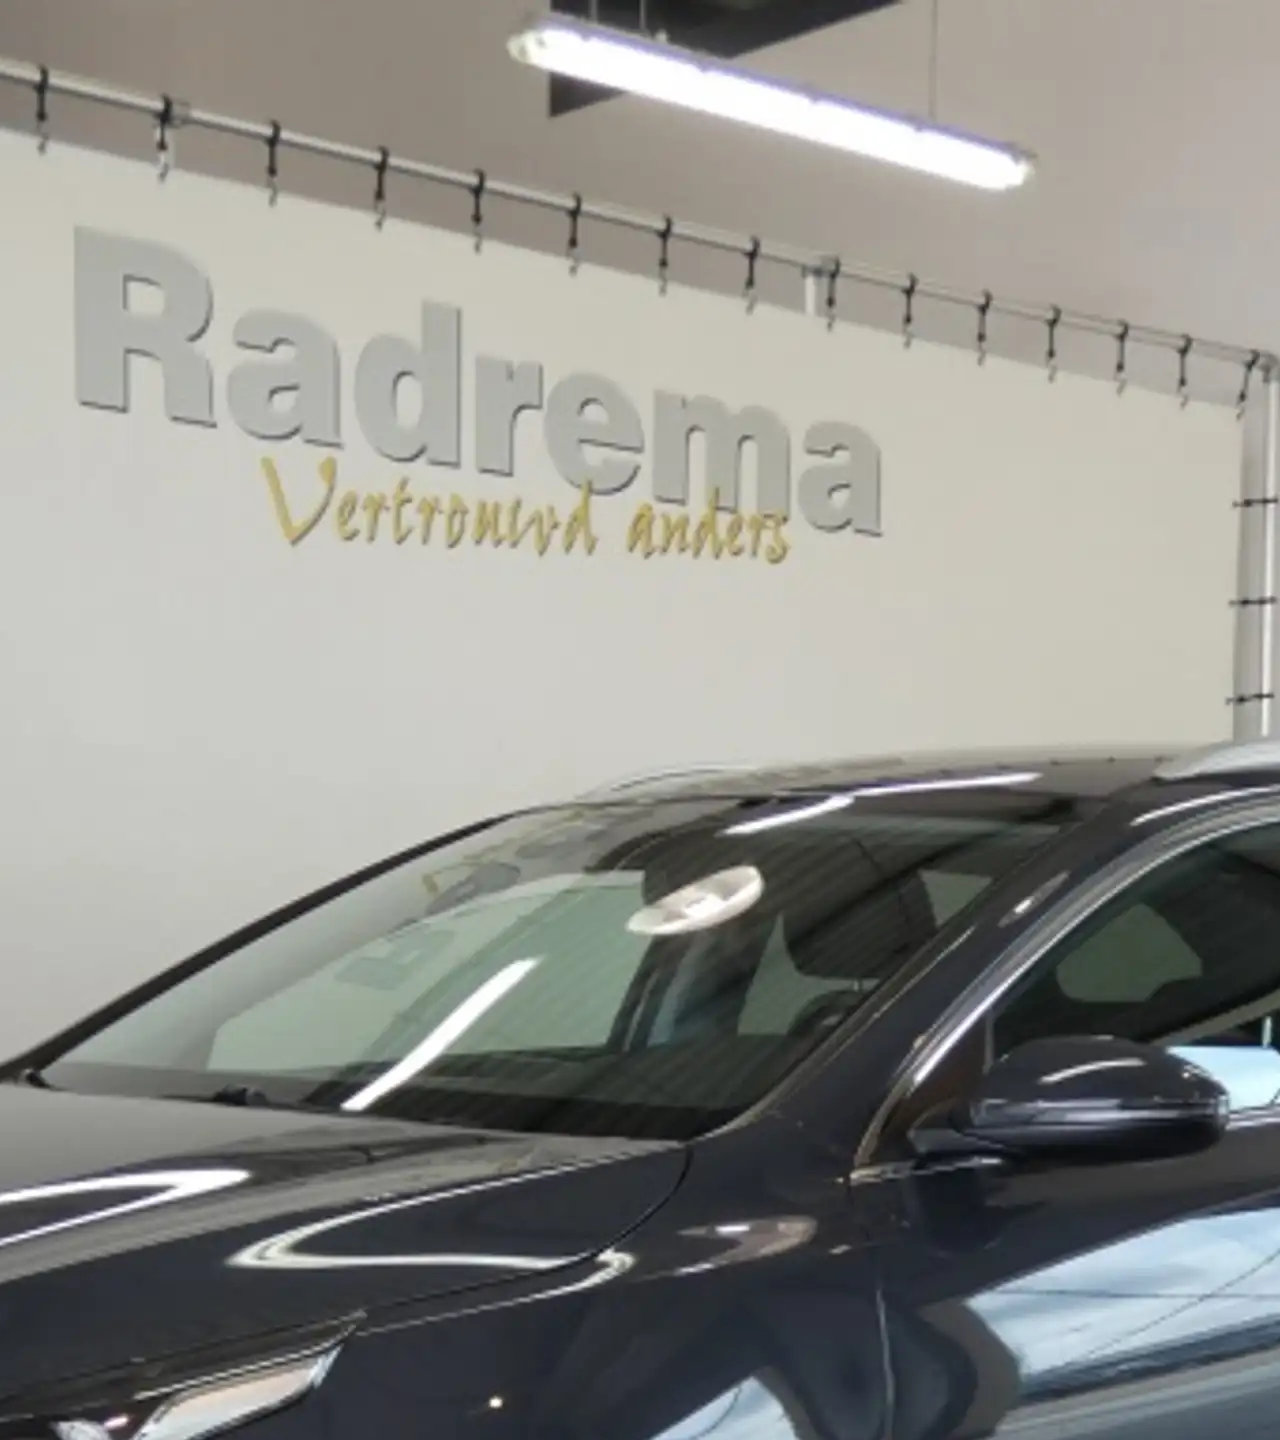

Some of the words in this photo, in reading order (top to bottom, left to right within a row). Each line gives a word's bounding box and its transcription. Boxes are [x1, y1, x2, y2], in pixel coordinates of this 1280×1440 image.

[73, 225, 882, 538] Radrema
[260, 456, 598, 559] Vertrouwd
[625, 484, 793, 565] anders
